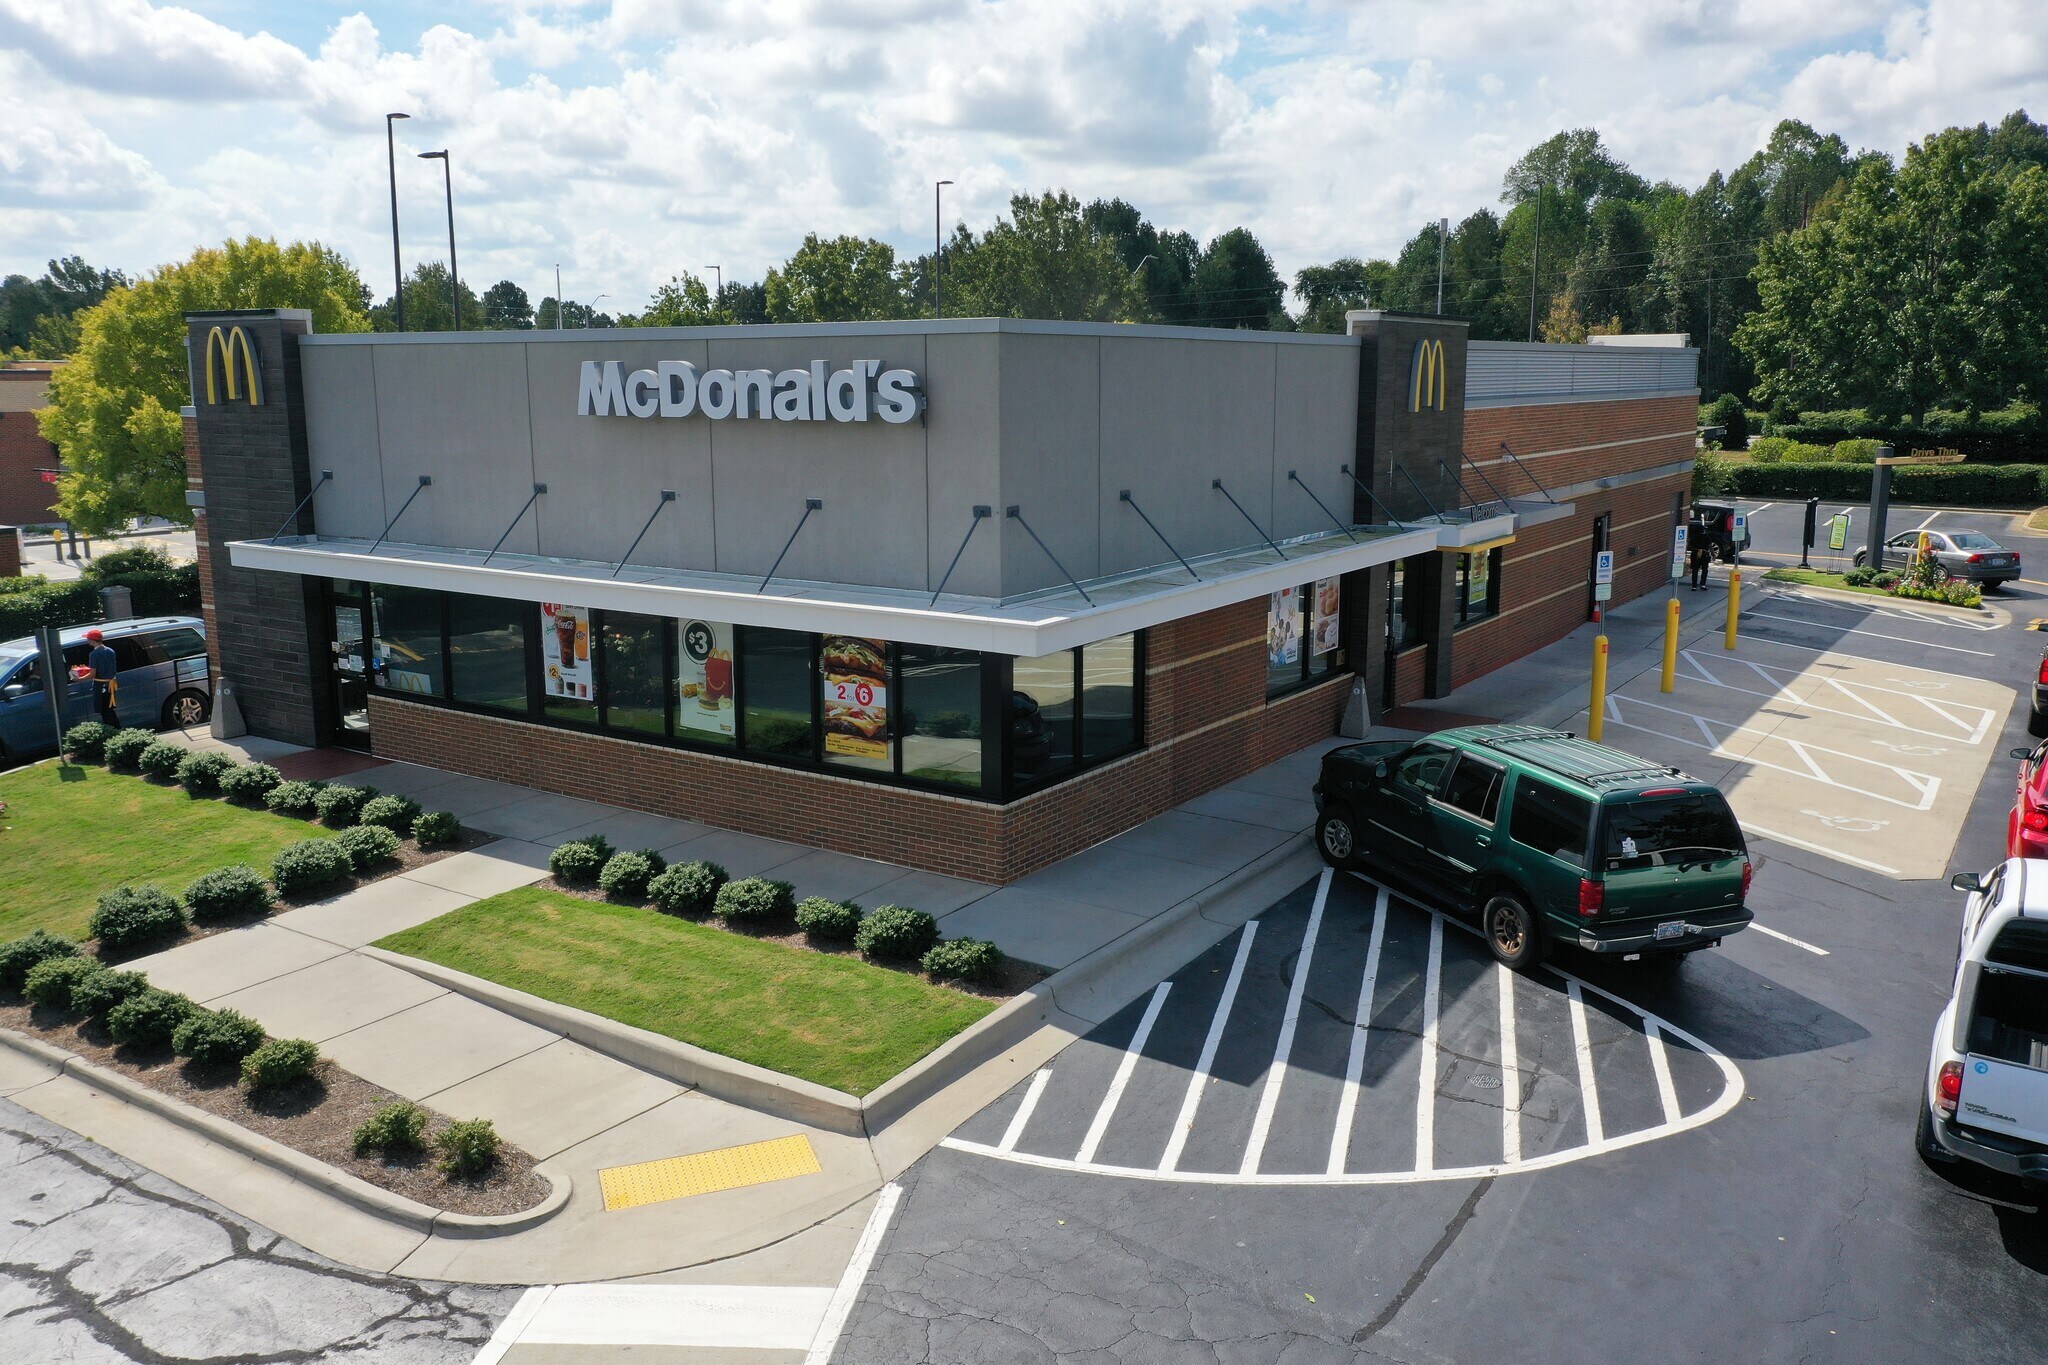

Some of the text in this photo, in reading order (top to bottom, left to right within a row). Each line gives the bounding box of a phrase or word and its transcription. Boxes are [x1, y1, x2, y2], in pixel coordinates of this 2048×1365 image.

[577, 359, 922, 424] McDonald's
[1910, 447, 1958, 457] Drive Thru
[1471, 505, 1500, 523] Welcome
[688, 630, 708, 654] $3
[838, 685, 846, 700] 2
